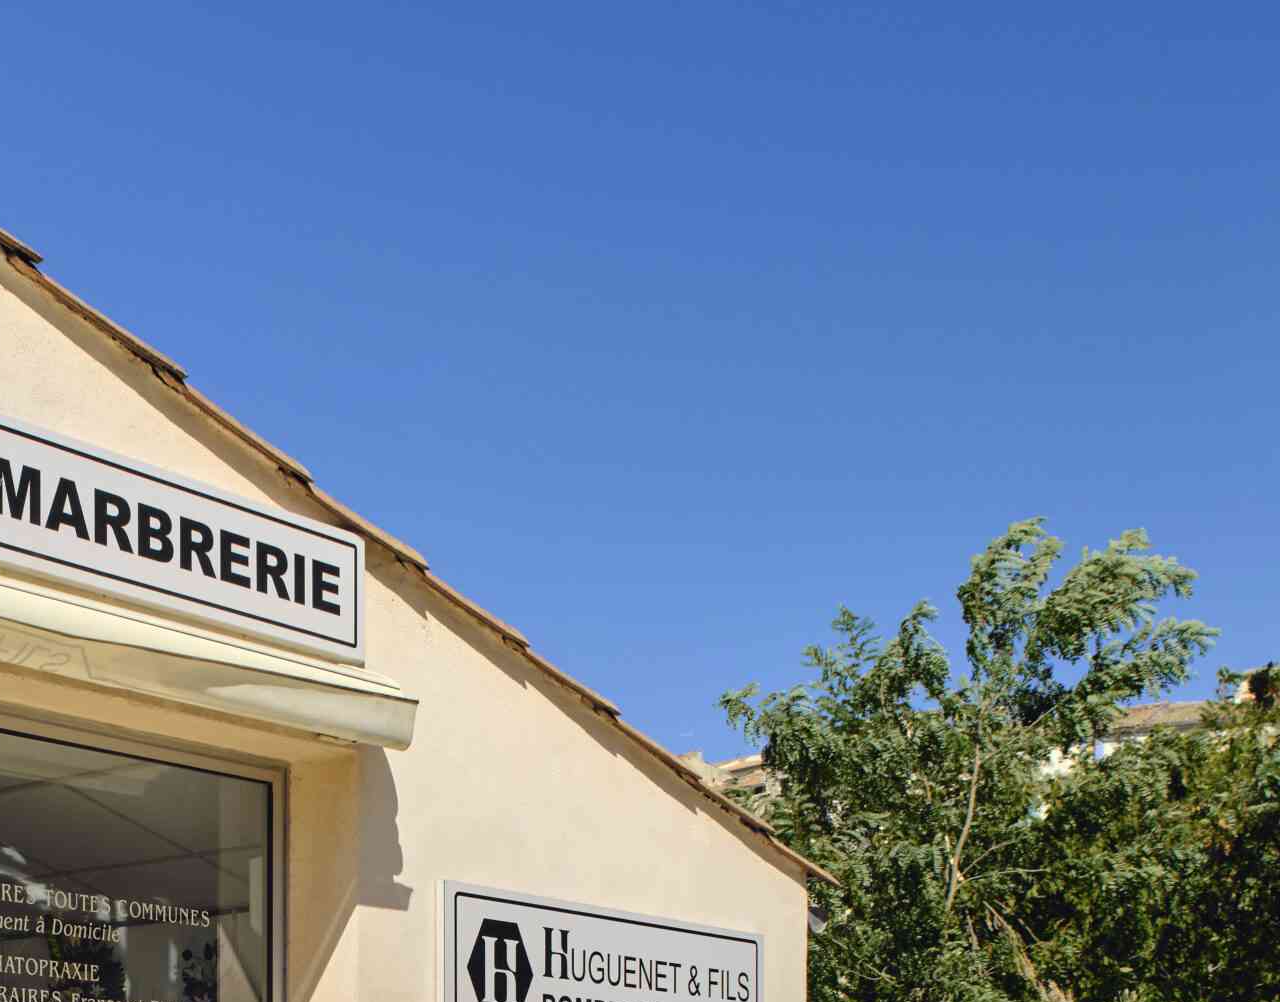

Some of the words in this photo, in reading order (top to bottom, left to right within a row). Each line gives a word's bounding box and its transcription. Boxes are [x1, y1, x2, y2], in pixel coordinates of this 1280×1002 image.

[42, 887, 112, 915] TOUTES
[118, 899, 212, 928] COMMUNES
[35, 915, 46, 935] à
[51, 918, 122, 944] Domicile
[542, 926, 682, 995] HUGUENET
[688, 966, 701, 997] &
[708, 968, 750, 1002] FILS
